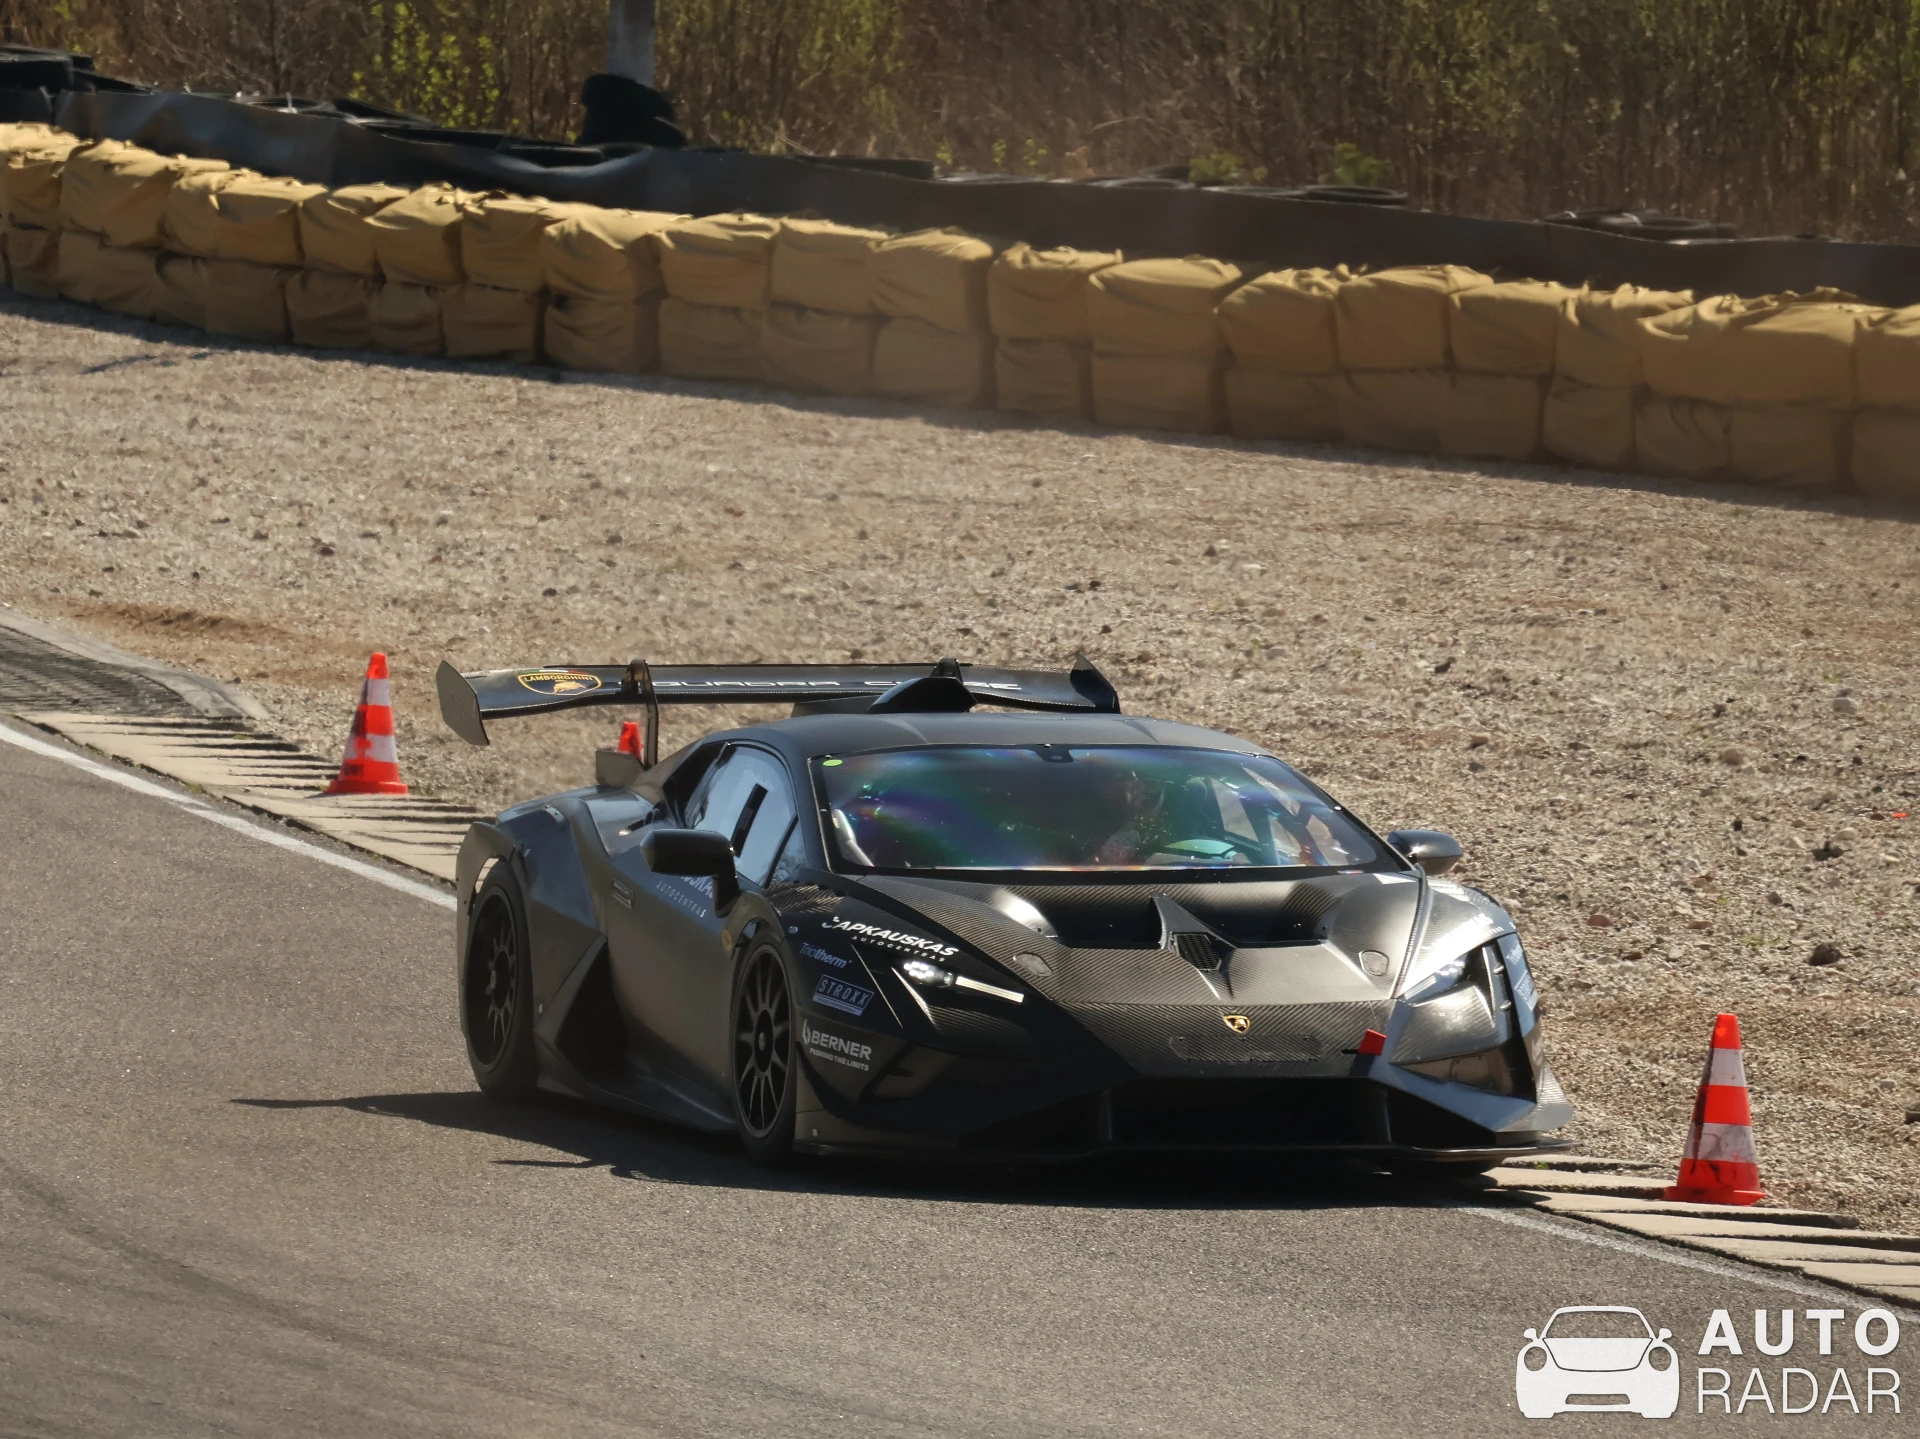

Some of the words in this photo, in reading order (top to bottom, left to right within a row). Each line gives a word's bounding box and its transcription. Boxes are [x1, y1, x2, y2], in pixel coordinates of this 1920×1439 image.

[524, 674, 593, 682] LAMBORGHINI
[851, 935, 946, 963] AUTOCENTRAS
[818, 979, 869, 1006] STROXX
[811, 1029, 872, 1060] BERNER
